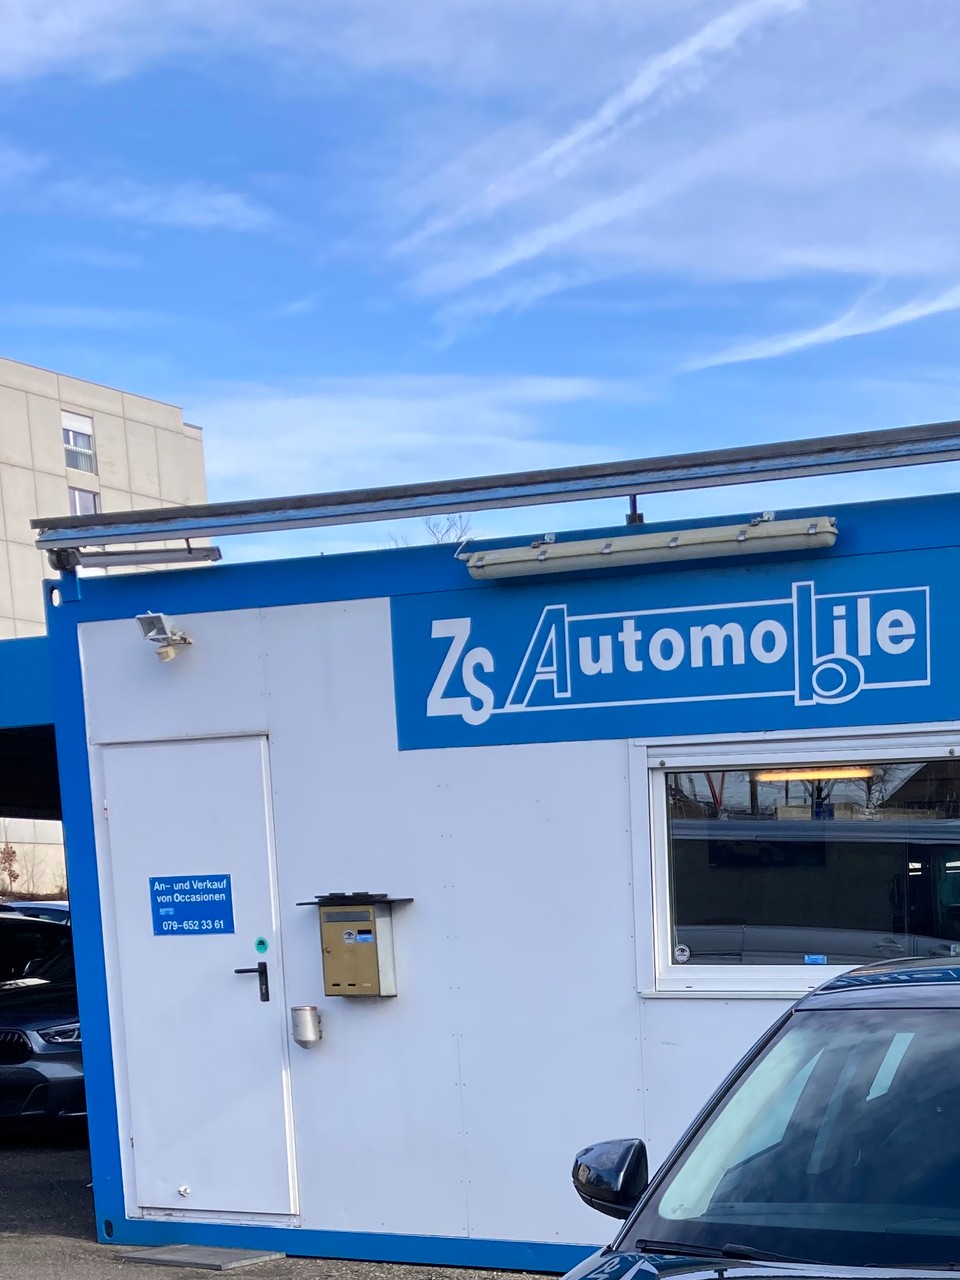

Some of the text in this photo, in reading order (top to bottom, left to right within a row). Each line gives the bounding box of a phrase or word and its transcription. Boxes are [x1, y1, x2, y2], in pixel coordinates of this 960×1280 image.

[506, 580, 917, 710] Automobile
[153, 879, 227, 891] An- und Verkauf
[156, 891, 226, 903] von Occasionen
[162, 919, 224, 931] 079-652 33 61
